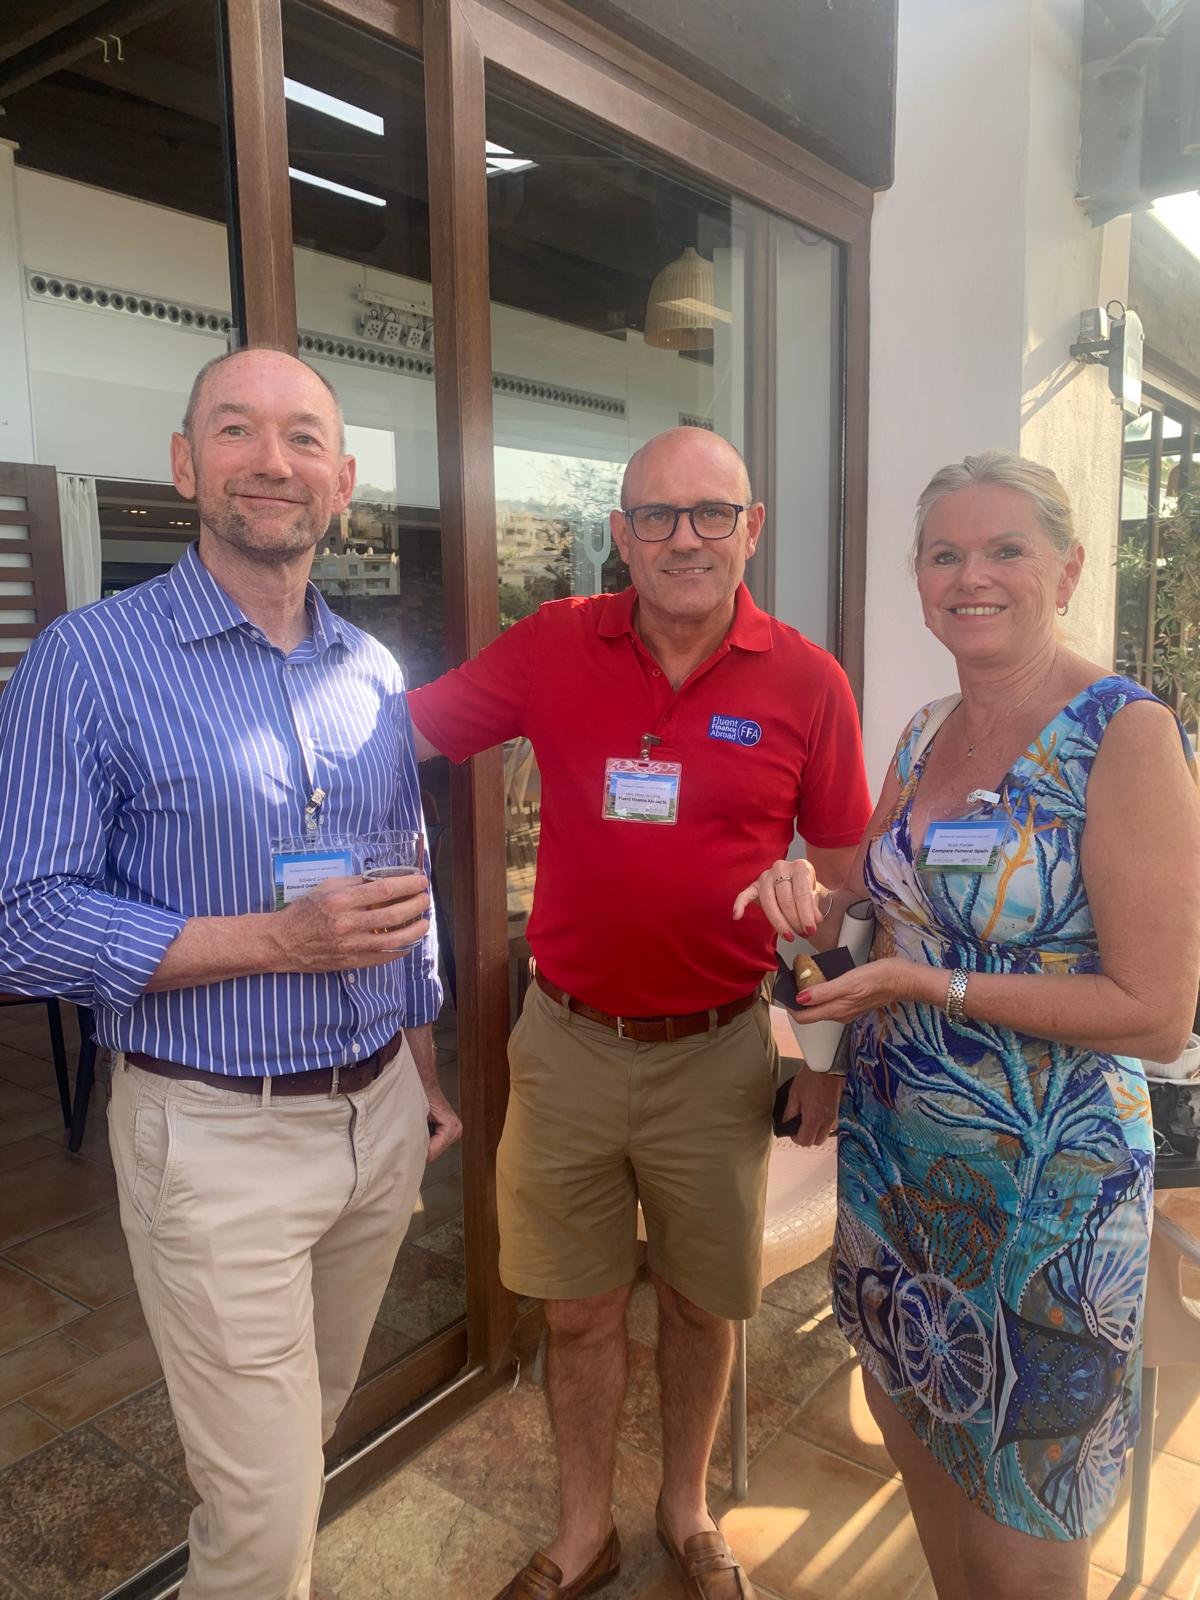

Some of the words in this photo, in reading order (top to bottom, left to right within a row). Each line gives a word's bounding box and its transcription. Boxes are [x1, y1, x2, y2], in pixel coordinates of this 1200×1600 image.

[712, 715, 738, 728] Fluent
[711, 723, 737, 733] Finance
[740, 726, 759, 741] FFA
[710, 729, 736, 741] Abroad
